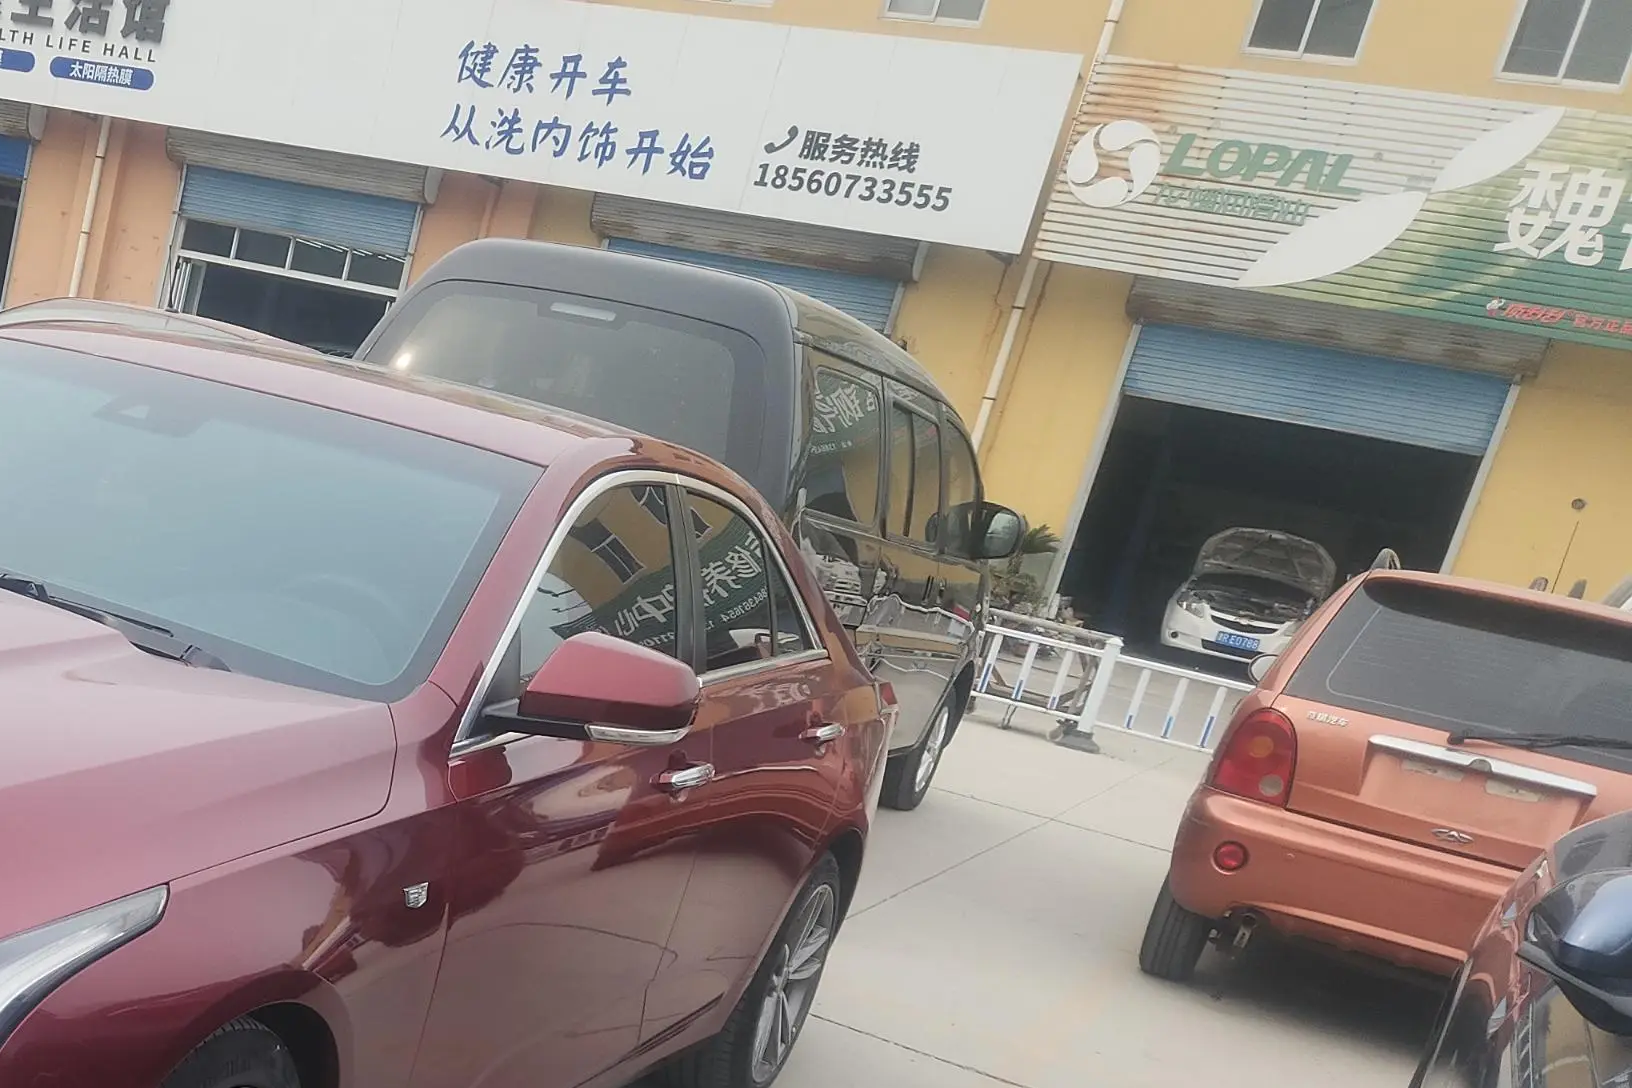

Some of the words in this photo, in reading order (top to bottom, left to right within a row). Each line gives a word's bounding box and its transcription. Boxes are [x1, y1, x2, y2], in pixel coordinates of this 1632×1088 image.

[46, 34, 92, 54] LIFE
[103, 43, 156, 63] HALL
[70, 62, 134, 86] 太阳隔热膜
[456, 39, 633, 106] 健康开车
[440, 103, 716, 181] 从洗内饰开始
[798, 129, 921, 174] 服务热线
[1162, 132, 1362, 196] LOPAL
[753, 162, 953, 212] 18560733555
[1493, 160, 1632, 271] 魏
